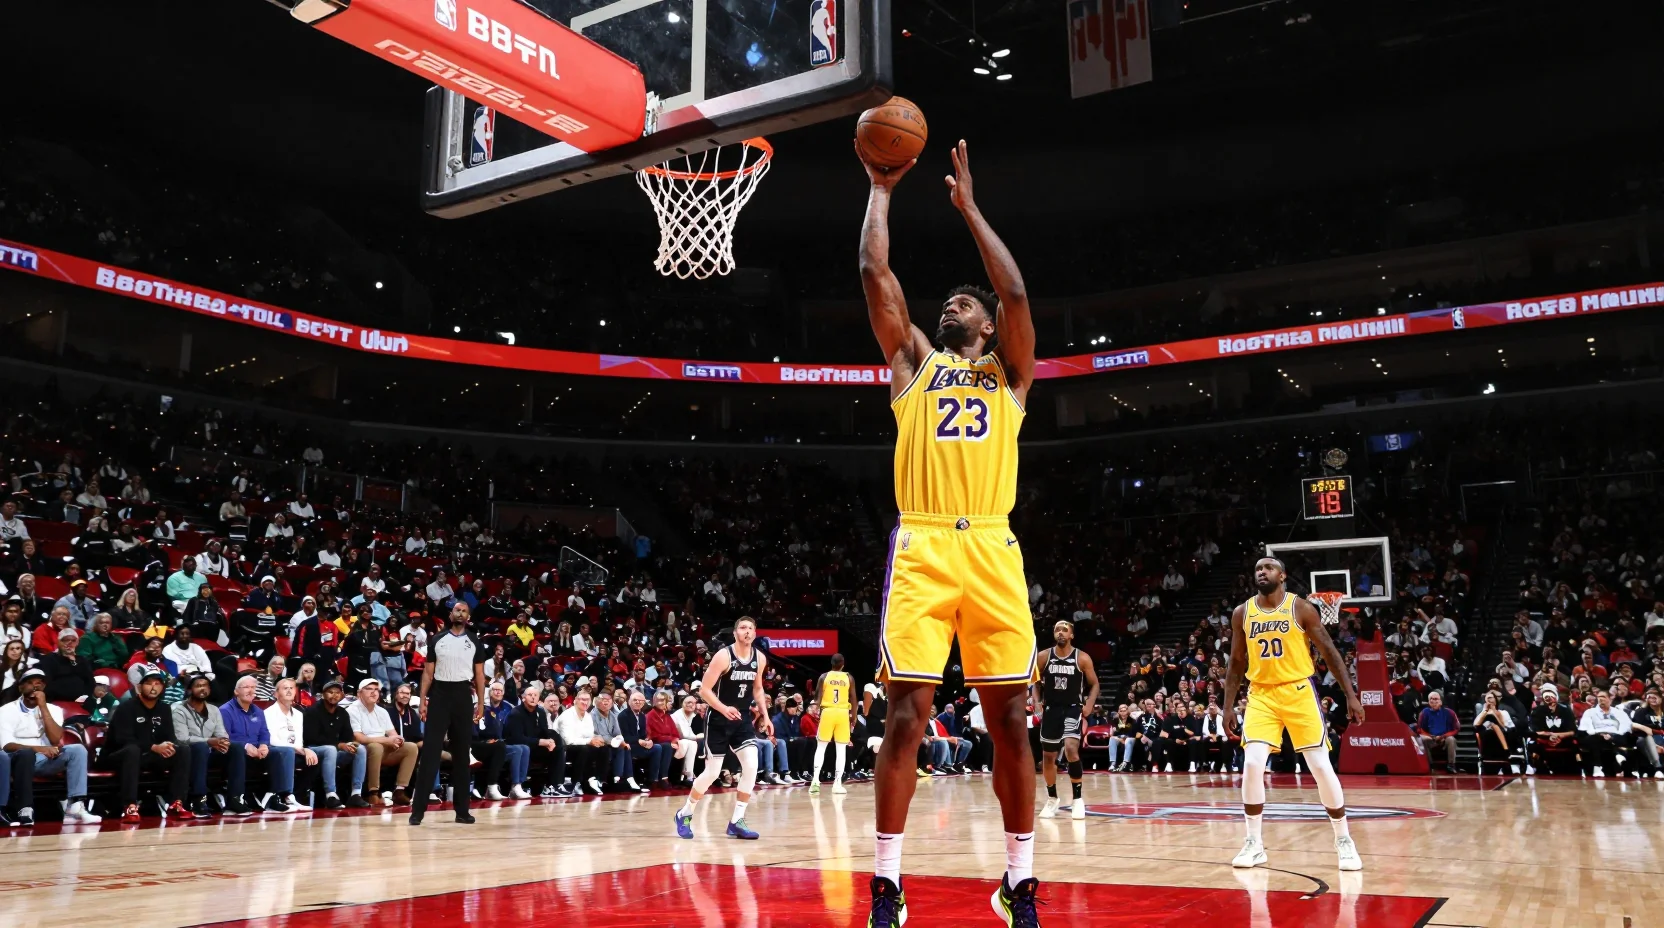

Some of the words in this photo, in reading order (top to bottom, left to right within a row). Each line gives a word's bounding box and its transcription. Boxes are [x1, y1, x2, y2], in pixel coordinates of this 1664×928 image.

[923, 363, 999, 393] LAKERS
[936, 397, 990, 441] 23
[1257, 638, 1284, 658] 20
